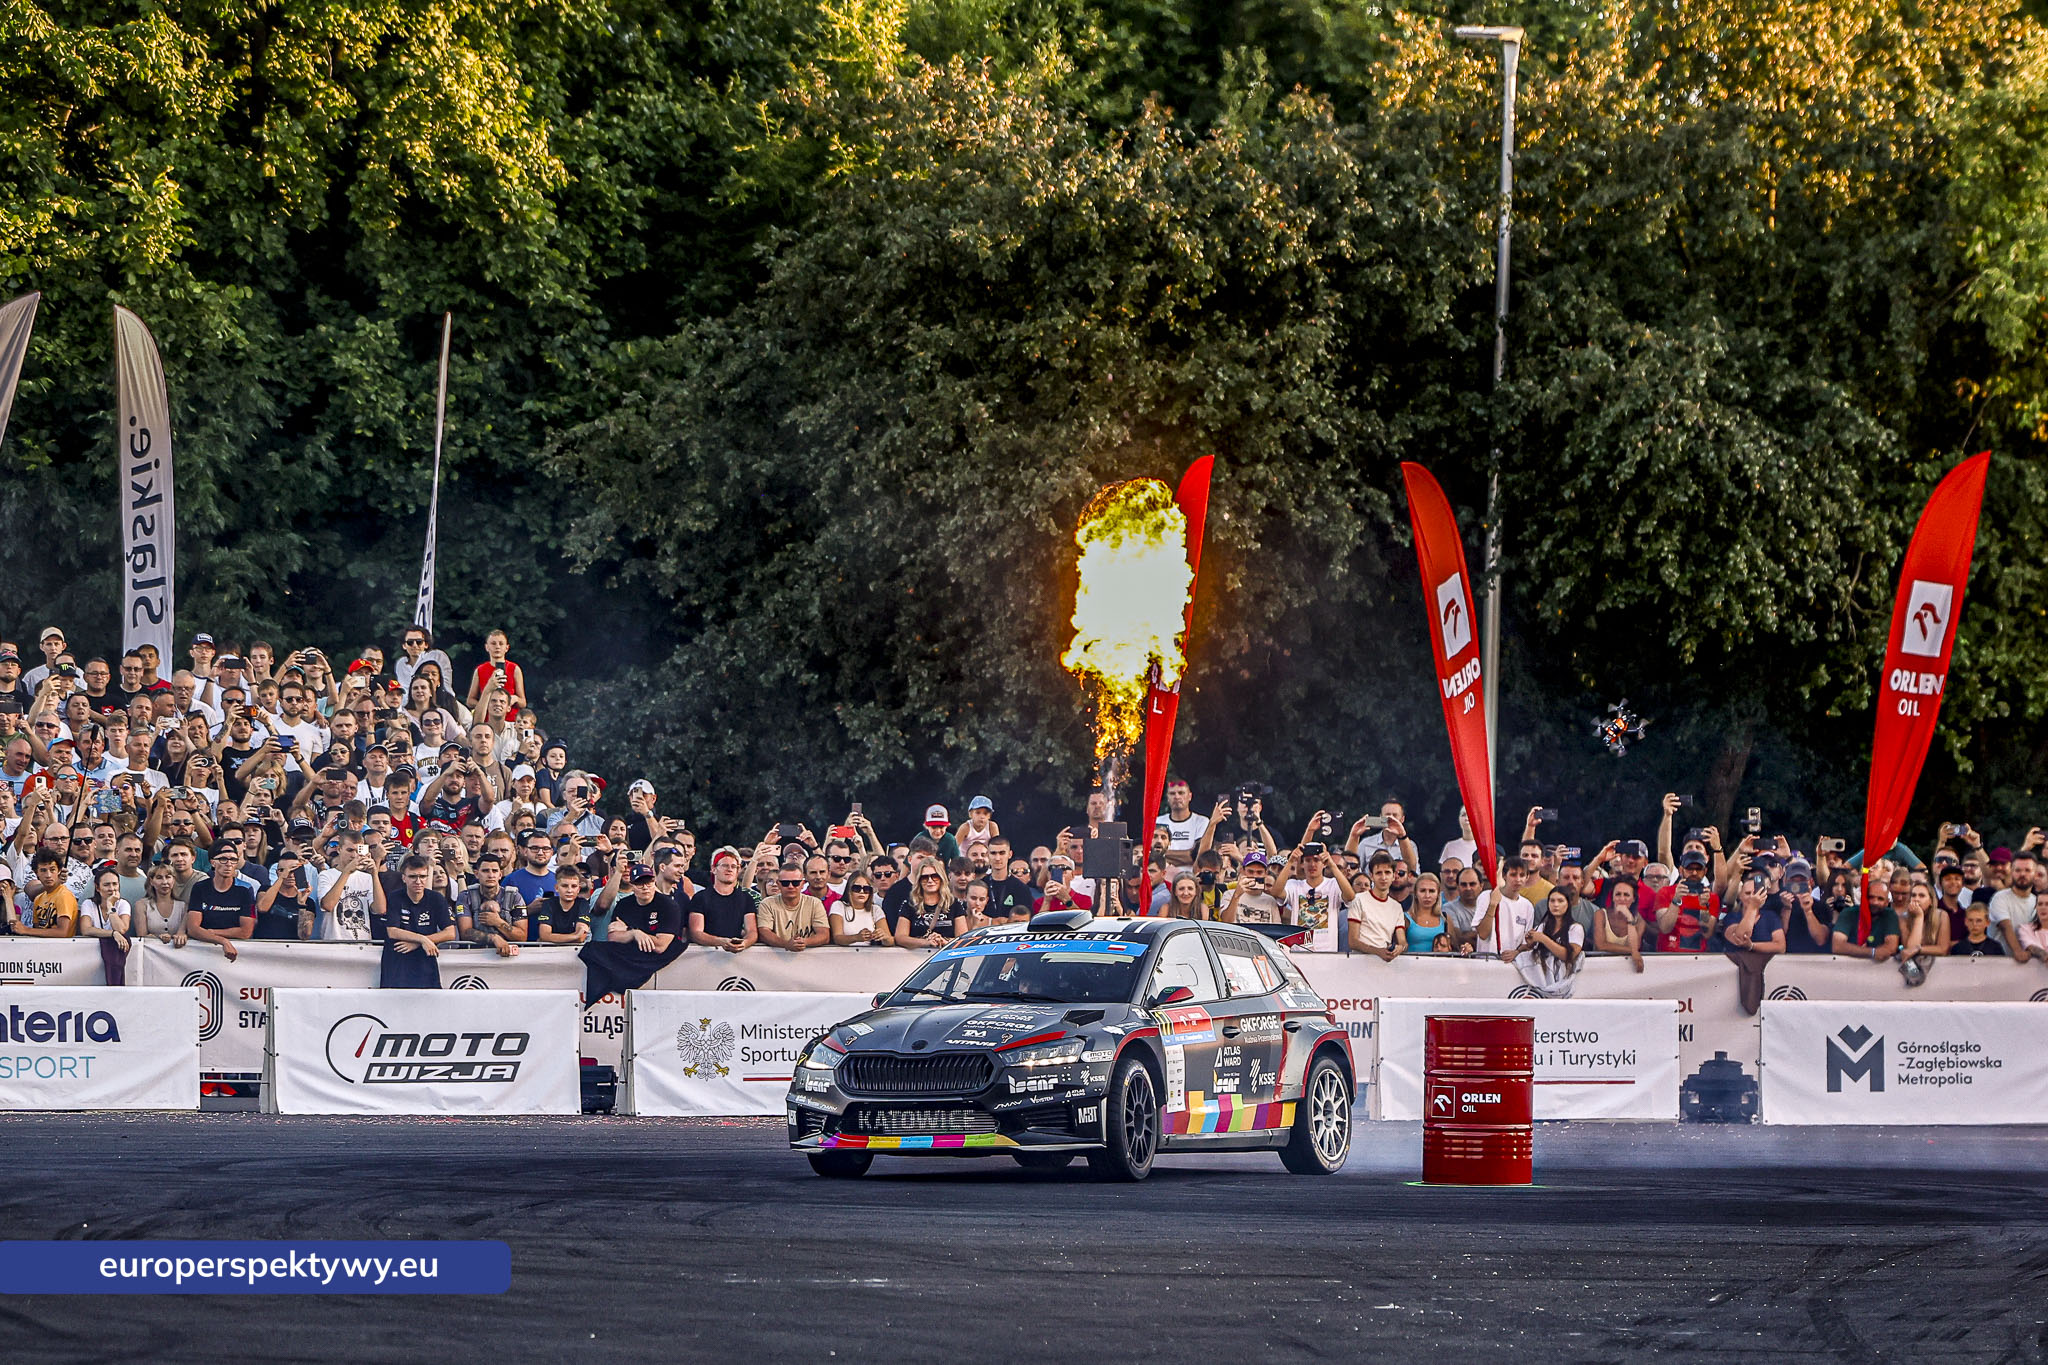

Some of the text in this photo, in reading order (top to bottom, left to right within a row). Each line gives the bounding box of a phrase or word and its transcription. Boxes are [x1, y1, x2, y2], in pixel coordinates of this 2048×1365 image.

[1890, 668, 1945, 695] ORLEN
[1897, 699, 1920, 716] OIL
[978, 932, 1124, 945] KATOWICE.EU
[26, 959, 63, 977] ŚLĄSKI
[1252, 954, 1274, 987] 17
[0, 1004, 121, 1043] teria
[966, 1020, 1035, 1029] GKFORGE
[1240, 1015, 1279, 1033] GKFORGE
[372, 1032, 531, 1057] MOTO
[1223, 1045, 1241, 1056] ATLAS
[1897, 1041, 1981, 1056] Górnośląsko
[741, 1046, 798, 1065] Sportu
[1223, 1056, 1242, 1067] WARD
[1549, 1050, 1554, 1066] i
[1558, 1049, 1636, 1069] Turystyki
[0, 1056, 97, 1079] SPORT
[368, 1064, 515, 1081] WIZJA
[1089, 1075, 1106, 1083] KSSE
[1258, 1072, 1276, 1086] KSSE
[1897, 1072, 1973, 1087] Metropolia
[1461, 1093, 1501, 1104] ORLEN
[1461, 1104, 1477, 1113] OIL
[858, 1110, 975, 1130] KATOWICE
